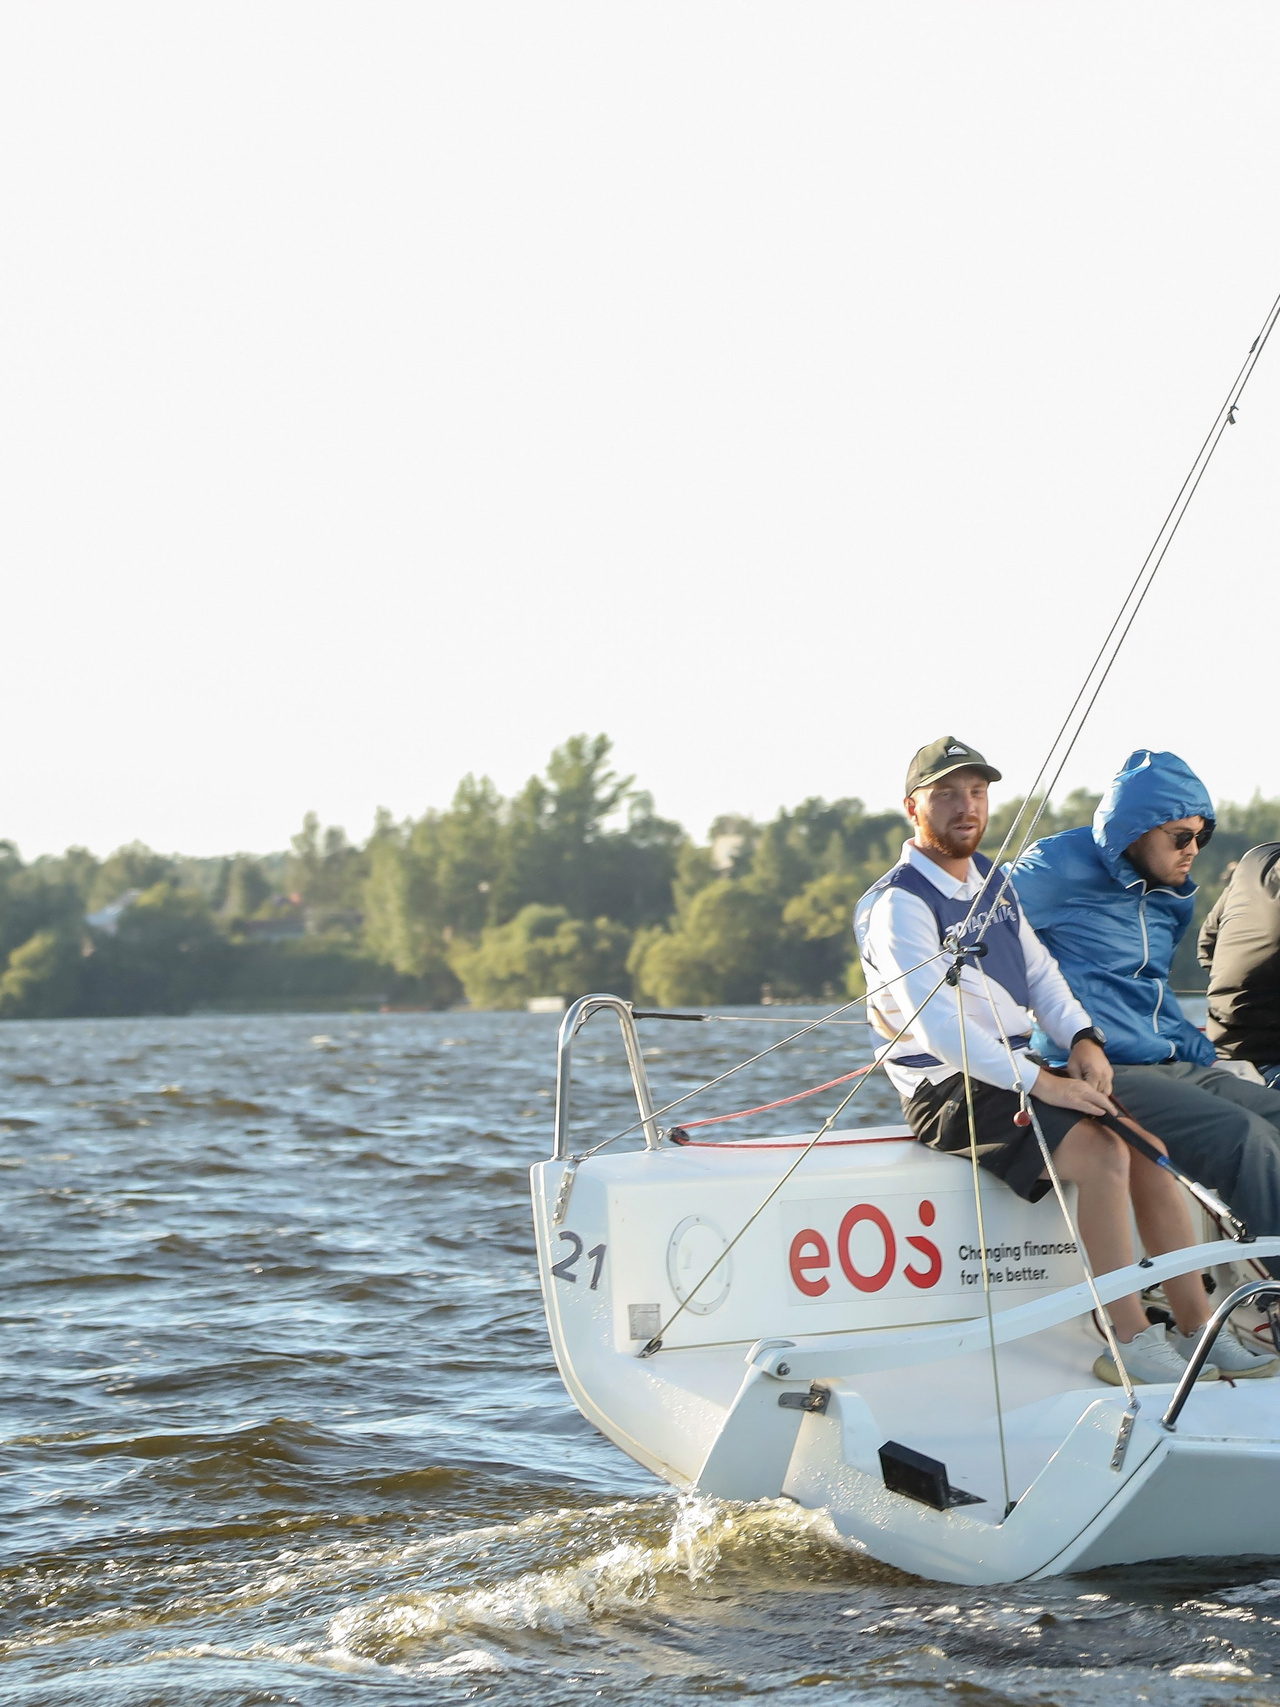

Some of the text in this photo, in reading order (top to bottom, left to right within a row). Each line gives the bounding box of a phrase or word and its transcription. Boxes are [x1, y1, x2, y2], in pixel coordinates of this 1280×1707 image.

[1023, 1240, 1078, 1257] finances
[551, 1230, 607, 1291] 21
[960, 1266, 1049, 1285] for he better.
